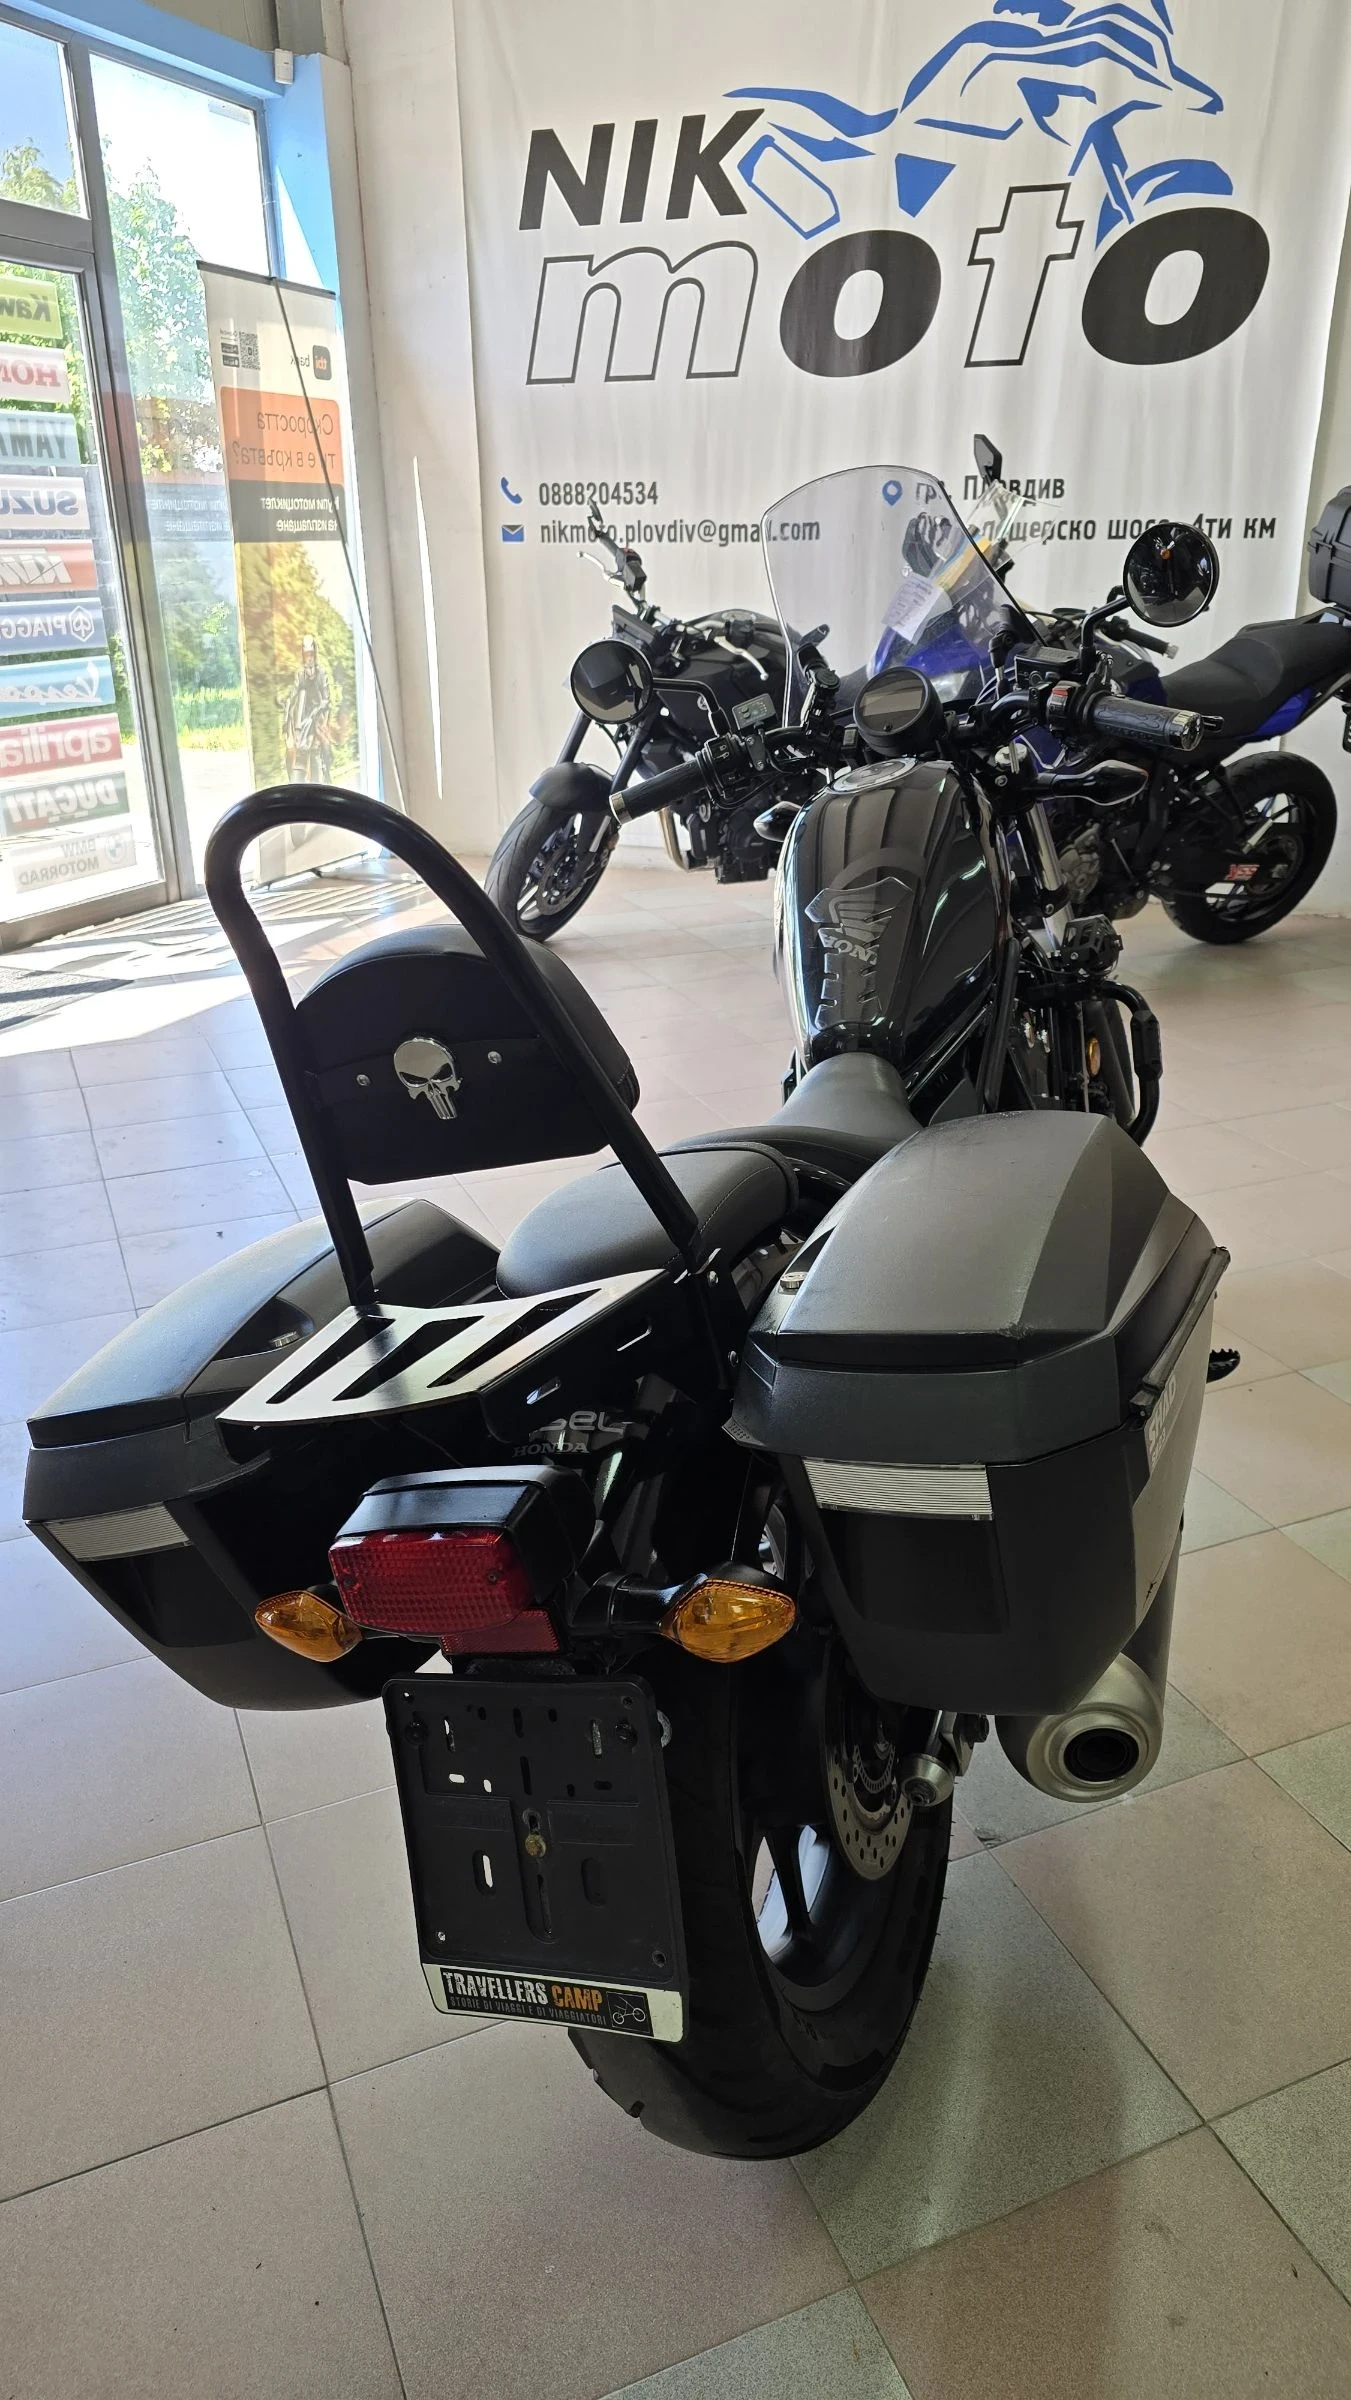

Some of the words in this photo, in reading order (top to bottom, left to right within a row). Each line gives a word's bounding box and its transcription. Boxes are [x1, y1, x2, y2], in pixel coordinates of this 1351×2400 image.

[518, 108, 765, 231] NIK
[525, 183, 1272, 386] moto
[538, 481, 659, 506] 0888204534
[964, 474, 1065, 507] Пвдив
[540, 519, 820, 547] nikmoo.plovdiv@gmal.com
[982, 519, 1097, 546] щерско
[1108, 518, 1170, 541] шо
[1244, 517, 1277, 539] км
[512, 1442, 590, 1458] HONDA
[443, 1971, 548, 2005] TRAVELLERS
[551, 1984, 603, 2012] CAMP
[450, 1997, 483, 2010] STORIE
[484, 2000, 494, 2011] DI
[496, 2000, 526, 2015] VIAGGI
[528, 2004, 534, 2016] E
[536, 2005, 546, 2017] DI
[549, 2006, 606, 2026] VIAGGIATORI
